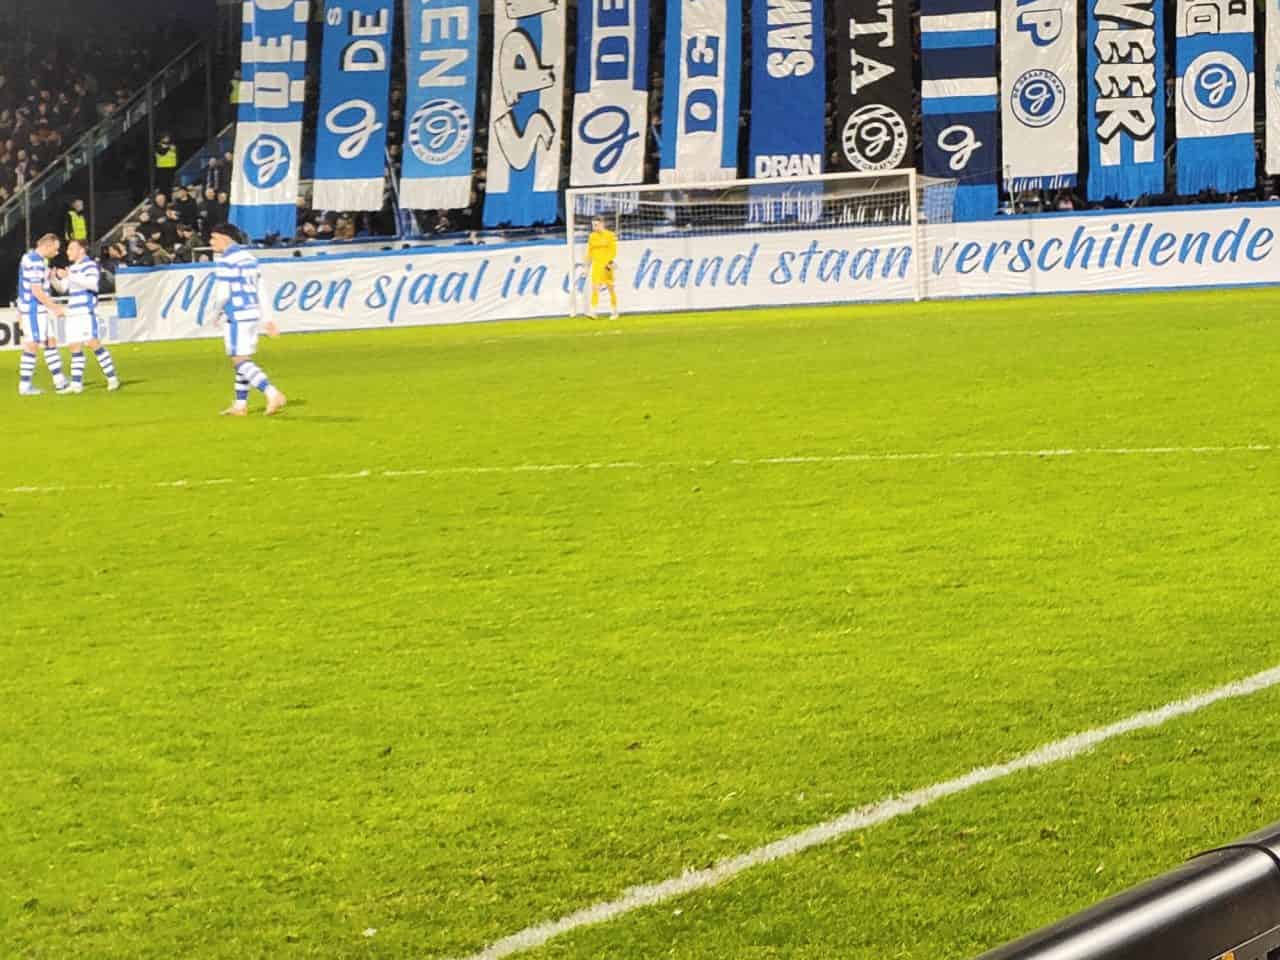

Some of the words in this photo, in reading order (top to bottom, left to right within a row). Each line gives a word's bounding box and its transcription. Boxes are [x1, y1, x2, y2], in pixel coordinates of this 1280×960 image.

[253, 34, 294, 109] DE
[343, 8, 389, 72] DE
[684, 35, 721, 135] DE
[755, 153, 822, 178] DRAN
[272, 277, 353, 312] een
[363, 259, 490, 323] sjaal
[501, 255, 548, 299] in
[633, 248, 761, 291] hand
[769, 239, 914, 286] staan
[932, 217, 1275, 276] verschillende
